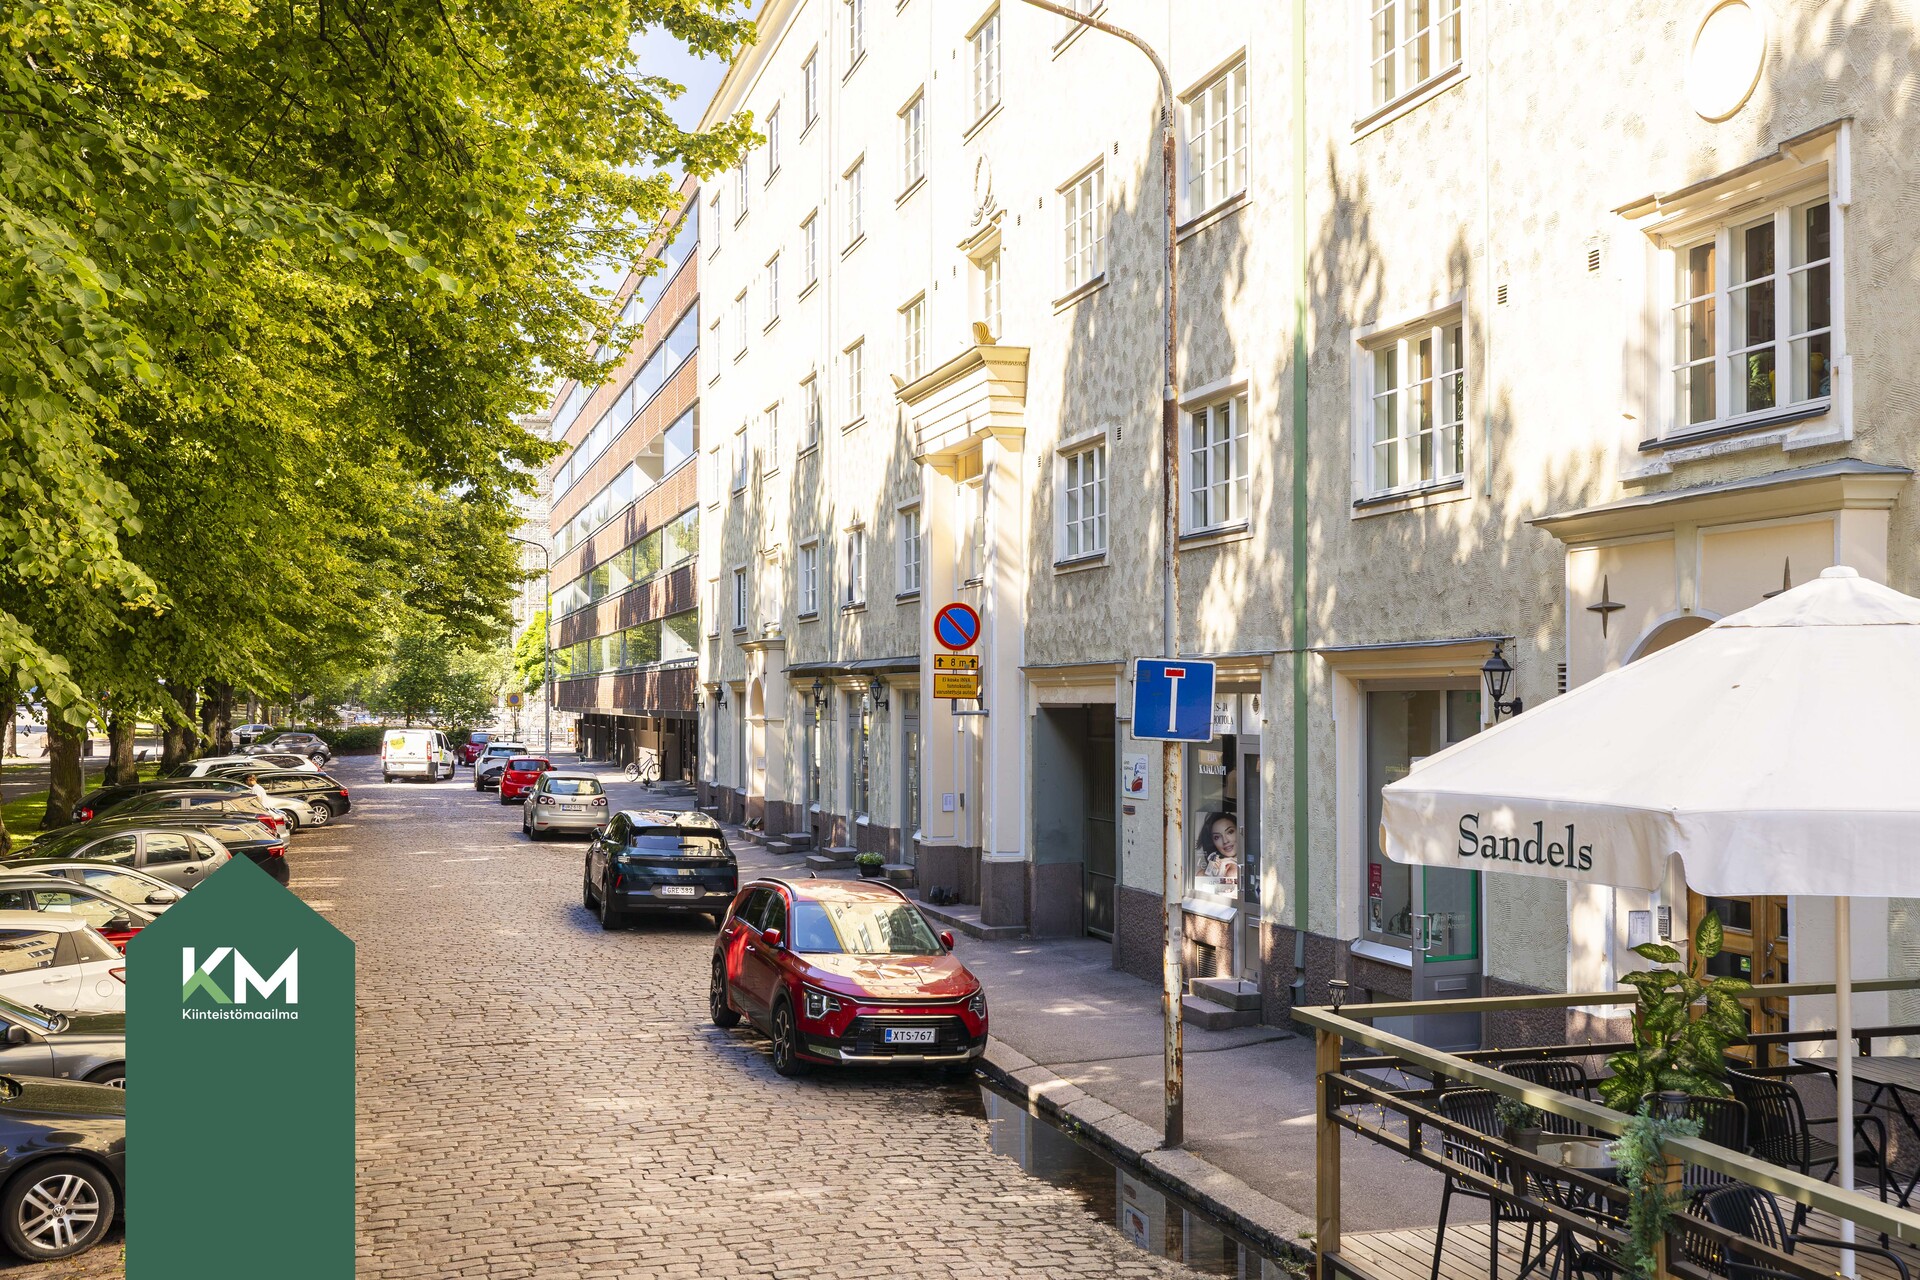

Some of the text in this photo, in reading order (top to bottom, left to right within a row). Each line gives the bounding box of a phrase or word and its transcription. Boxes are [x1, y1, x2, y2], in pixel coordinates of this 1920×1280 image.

[951, 658, 967, 667] 8 m
[1457, 812, 1593, 872] Sandels
[893, 1031, 933, 1041] XTS-767
